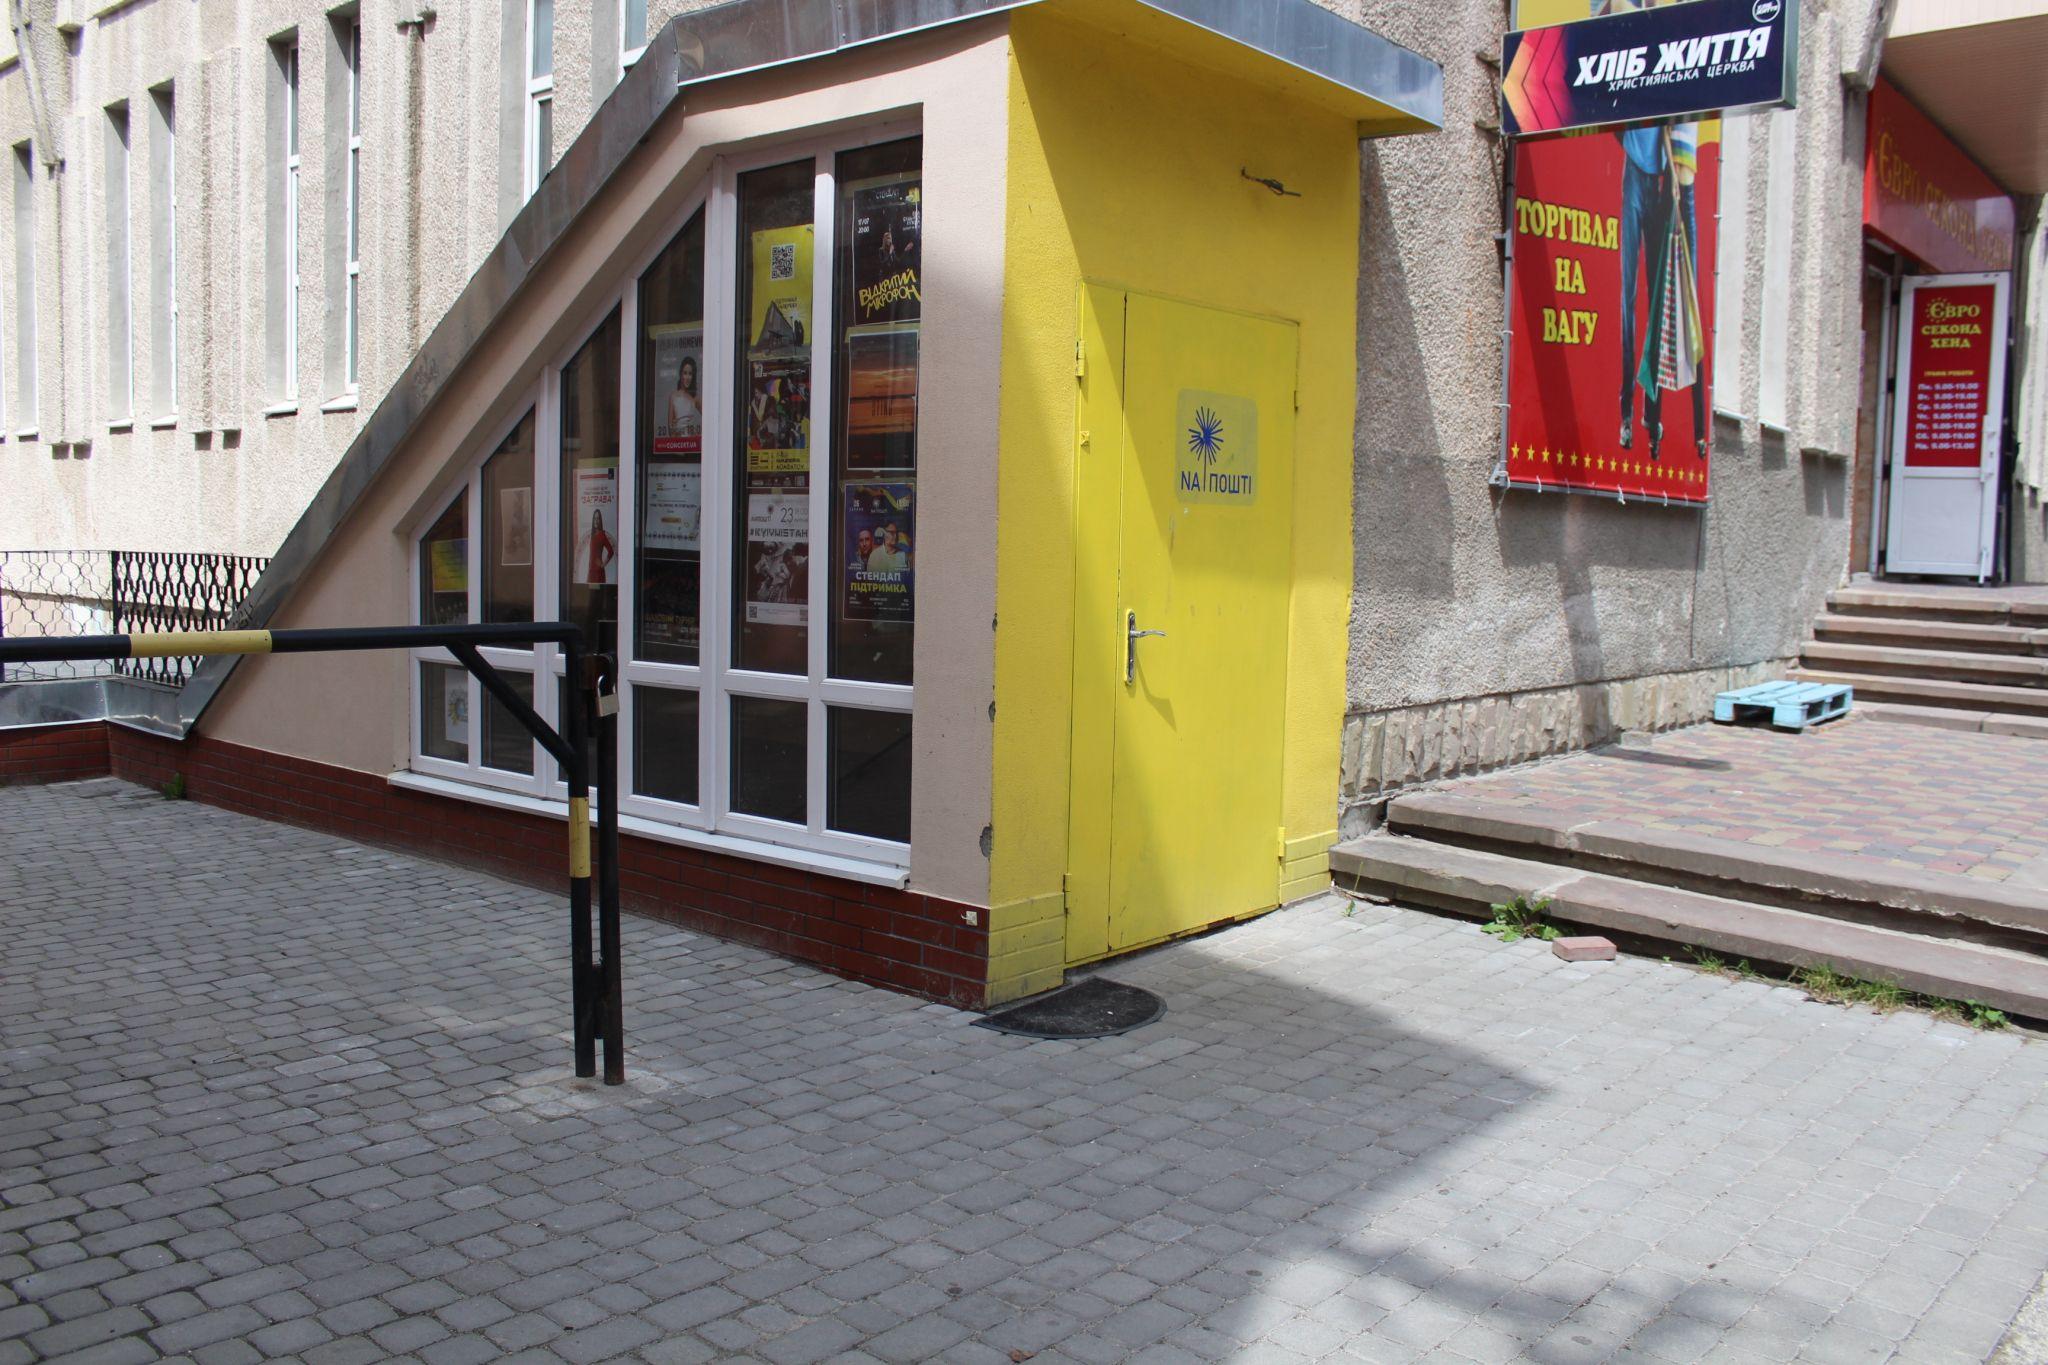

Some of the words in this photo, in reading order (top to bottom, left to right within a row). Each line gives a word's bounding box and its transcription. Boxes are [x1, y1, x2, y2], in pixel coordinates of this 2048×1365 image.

[1573, 46, 1648, 87] ХЛІБ
[1652, 25, 1772, 74] ЖИТТЯ
[1608, 67, 1700, 92] ХРИСТИЯНСЬКА
[1706, 60, 1755, 78] ЦЕРКВА
[1516, 197, 1619, 250] ТОРГІВЛЯ
[1555, 257, 1587, 295] НА
[1929, 302, 1981, 318] ЄВРО
[1542, 307, 1599, 345] ВАГУ
[1921, 324, 1982, 335] СЕКОНД
[1930, 337, 1971, 348] ХЕНД
[1209, 473, 1252, 495] ПОШТІ
[780, 507, 794, 523] 23
[855, 571, 901, 582] СТЕНДАП
[850, 582, 907, 593] ПІДТРИМКА
